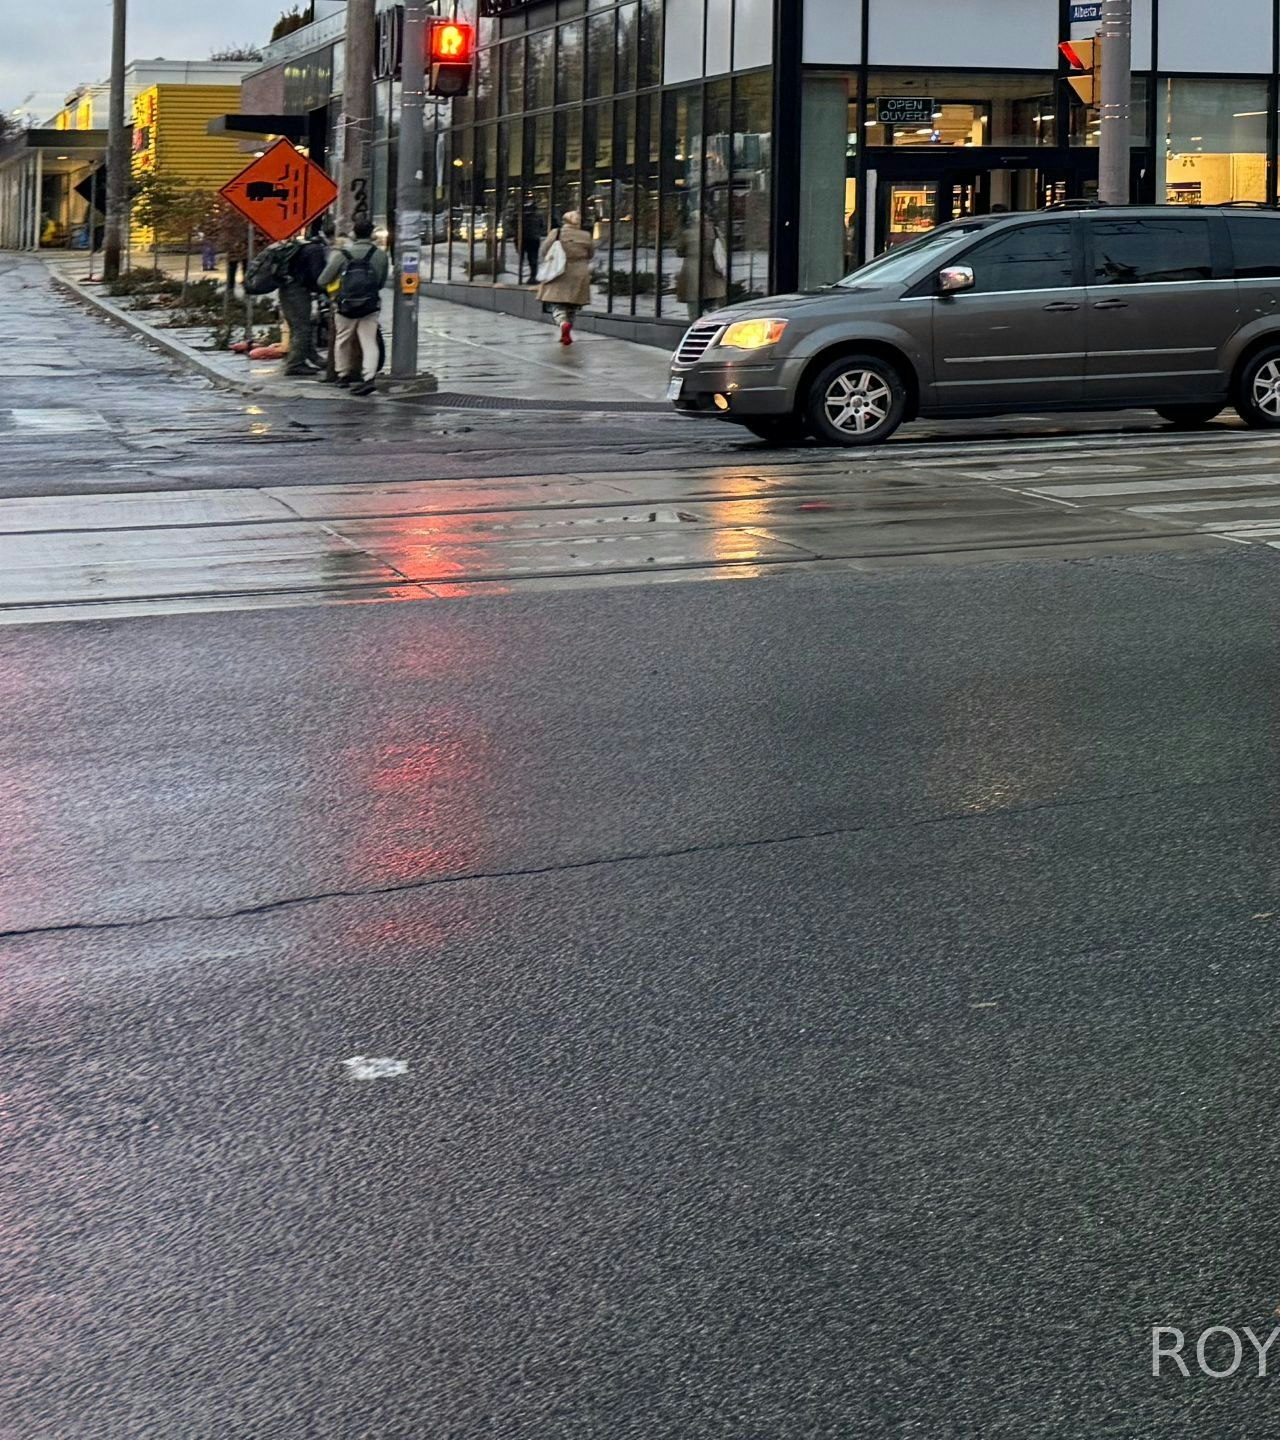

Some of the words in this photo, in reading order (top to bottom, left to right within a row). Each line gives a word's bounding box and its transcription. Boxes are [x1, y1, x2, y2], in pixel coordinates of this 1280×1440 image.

[1074, 6, 1097, 18] Alberta
[887, 100, 923, 110] OPEN
[880, 111, 929, 121] OUVERT
